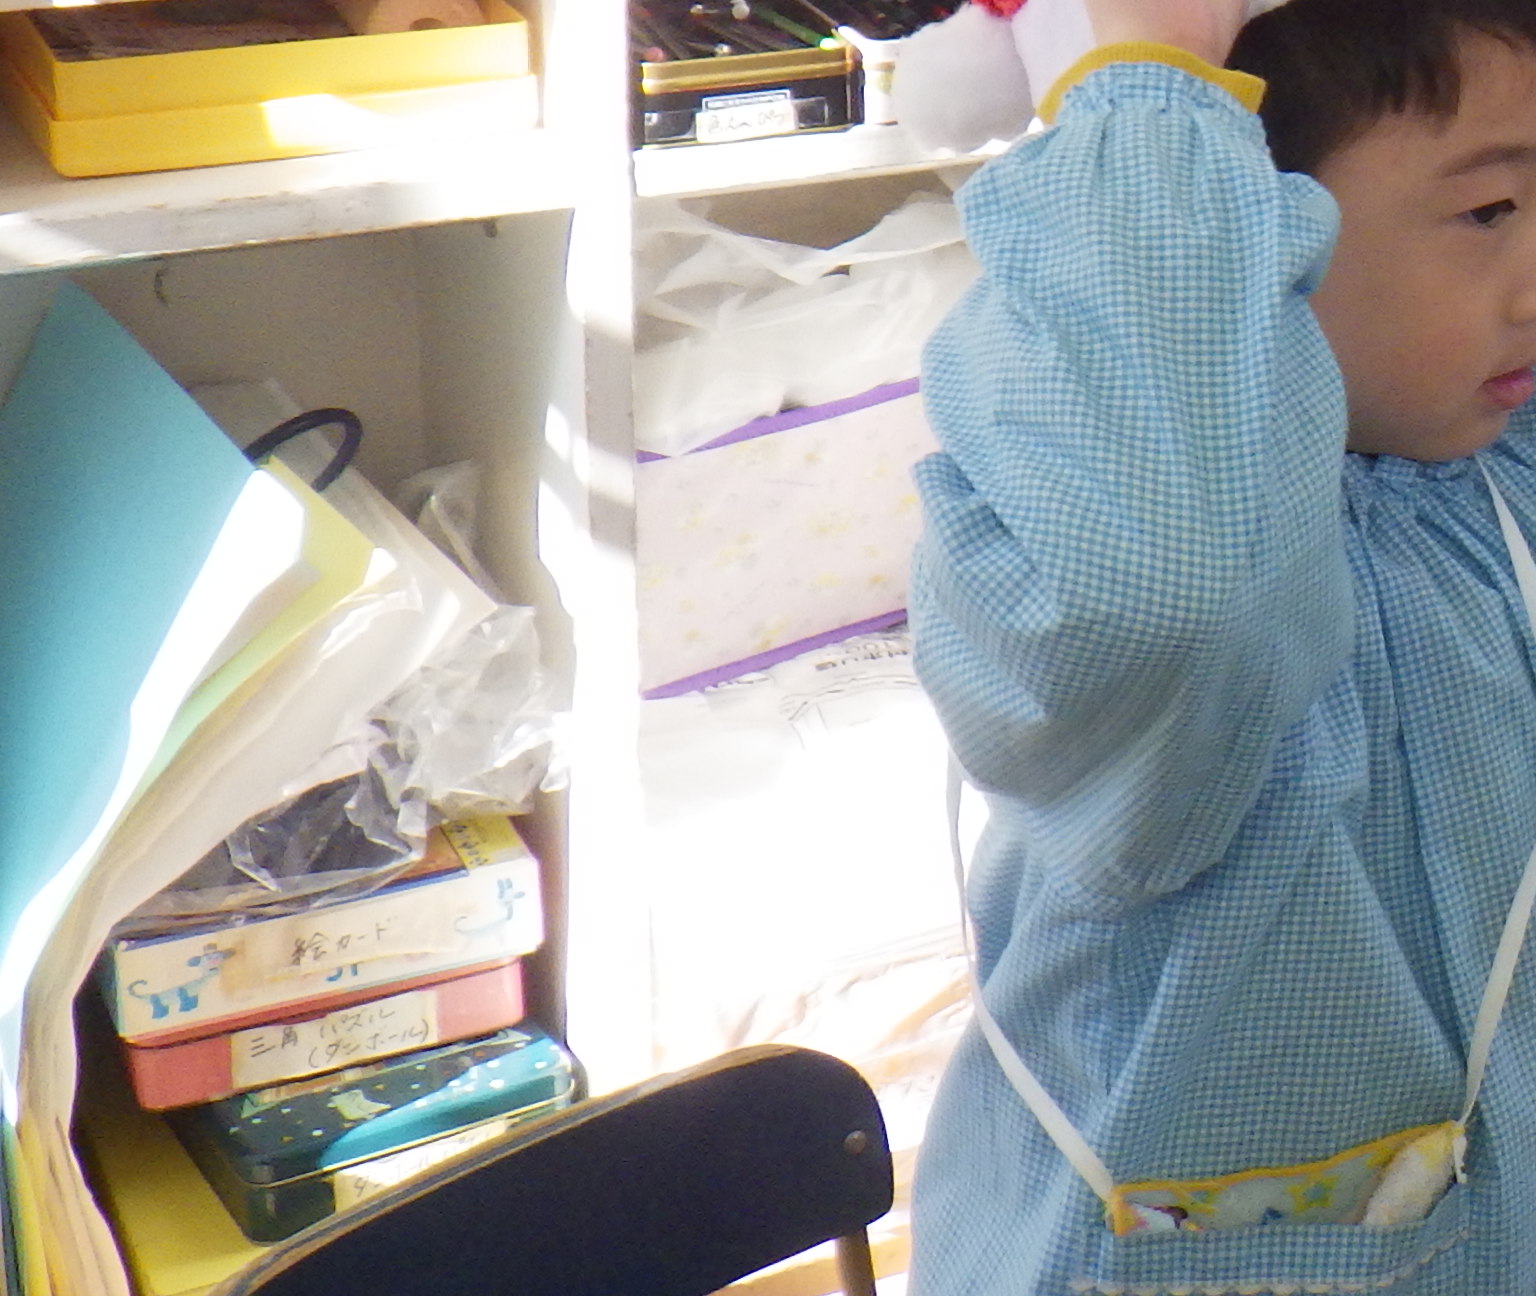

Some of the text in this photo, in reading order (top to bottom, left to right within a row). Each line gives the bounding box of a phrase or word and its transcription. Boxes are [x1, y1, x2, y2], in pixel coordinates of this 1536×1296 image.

[291, 915, 398, 966] 絵カード
[251, 1008, 396, 1058] 三角 パズル
